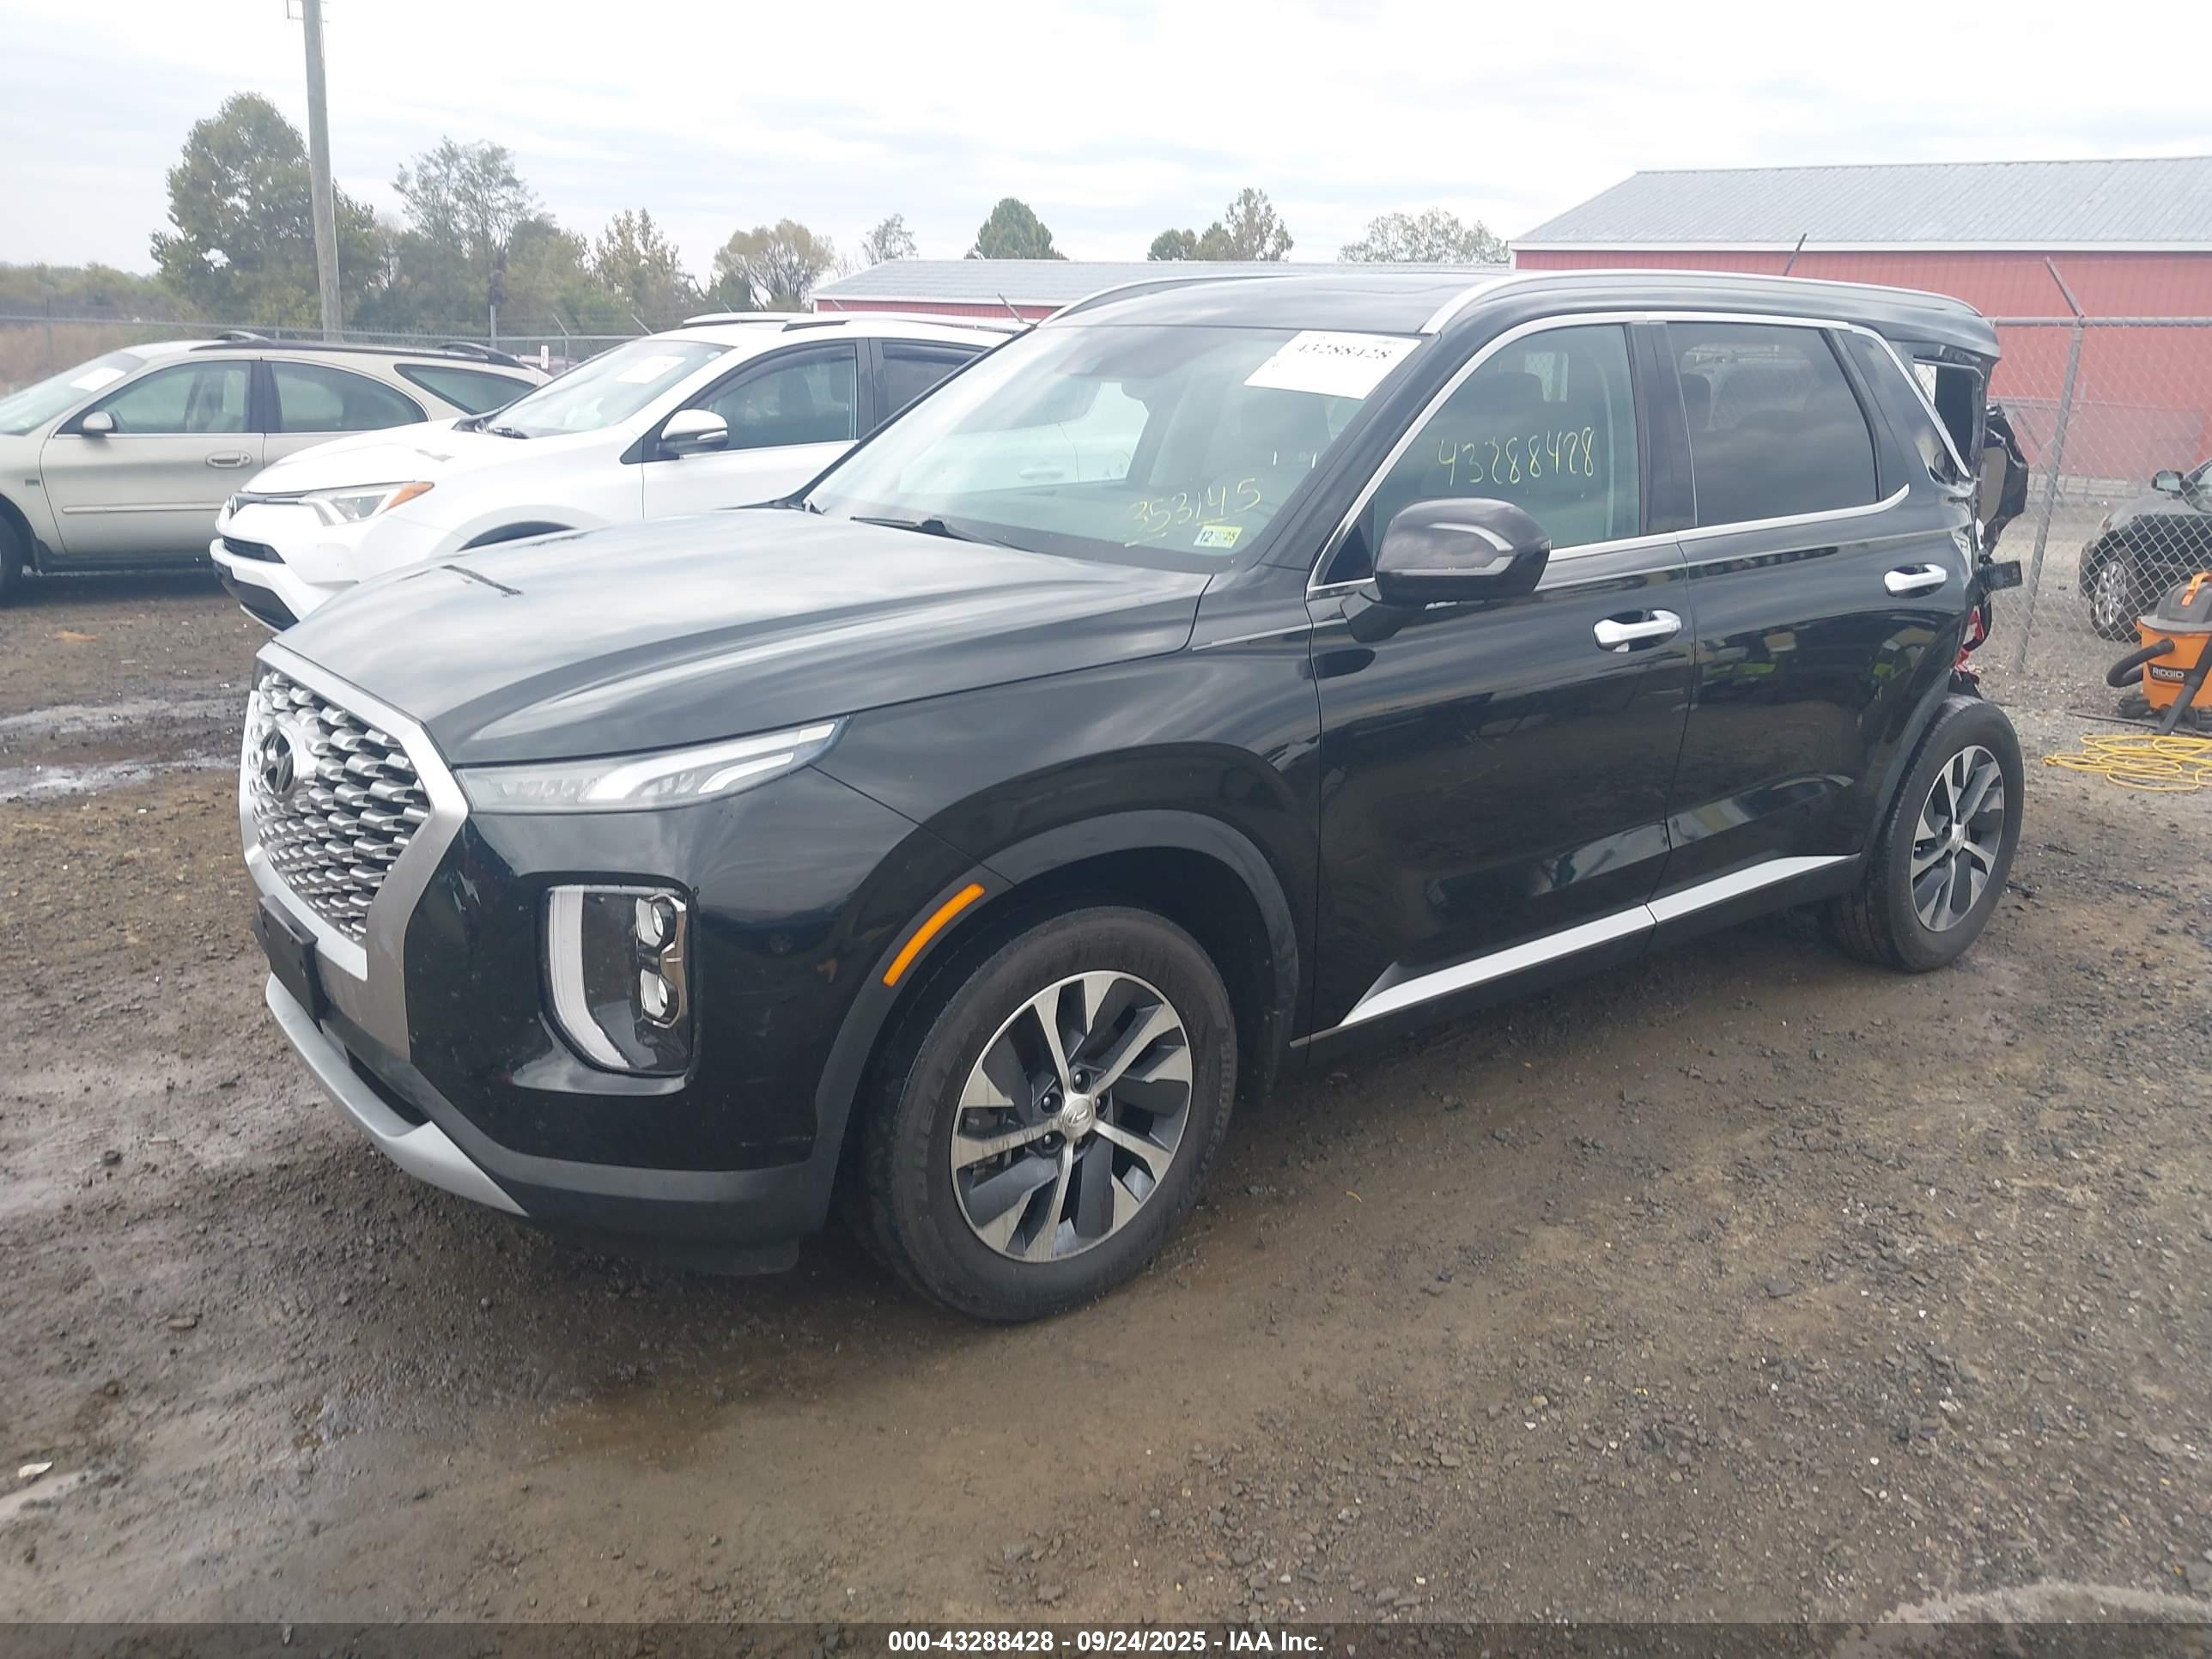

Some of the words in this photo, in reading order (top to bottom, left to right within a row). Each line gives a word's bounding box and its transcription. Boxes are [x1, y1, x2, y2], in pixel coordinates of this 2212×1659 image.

[1438, 427, 1595, 488] 43288428
[1200, 530, 1214, 543] 12
[2152, 666, 2185, 678] RIDGID
